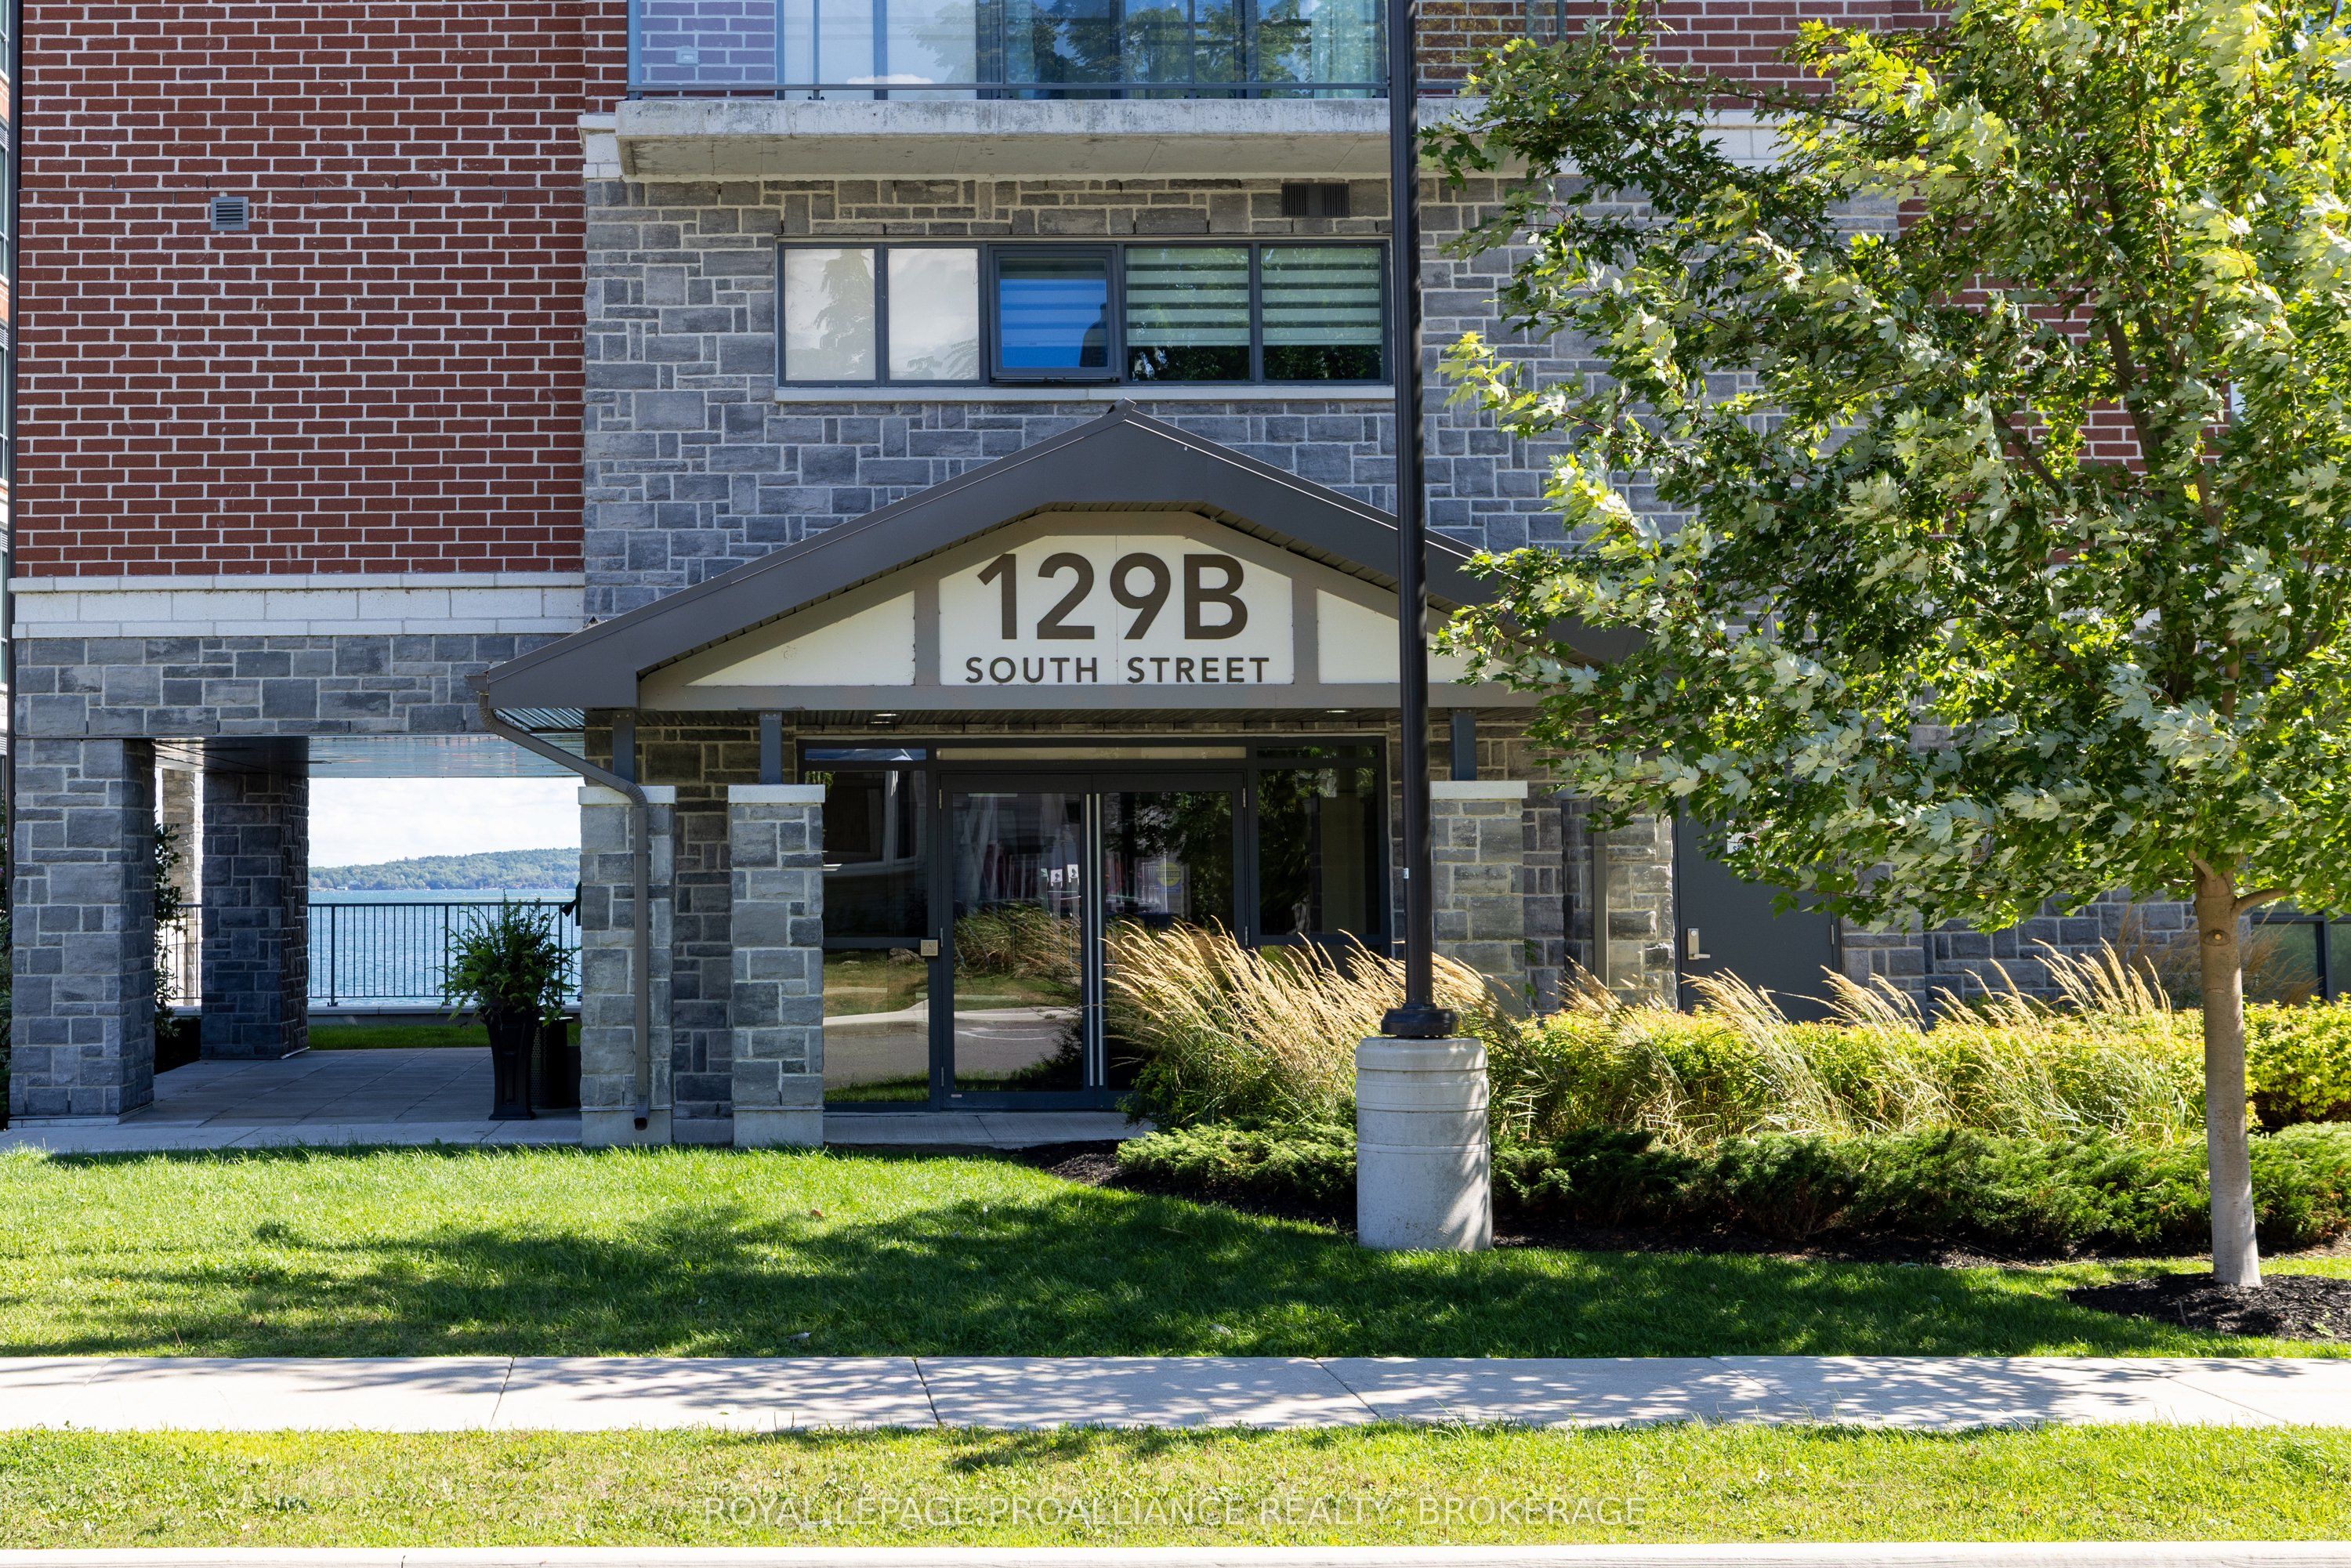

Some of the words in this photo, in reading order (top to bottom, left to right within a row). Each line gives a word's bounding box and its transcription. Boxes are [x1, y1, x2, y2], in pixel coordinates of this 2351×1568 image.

[976, 552, 1248, 640] 129B
[965, 656, 1098, 683] SOUTH
[1126, 656, 1270, 683] STREET
